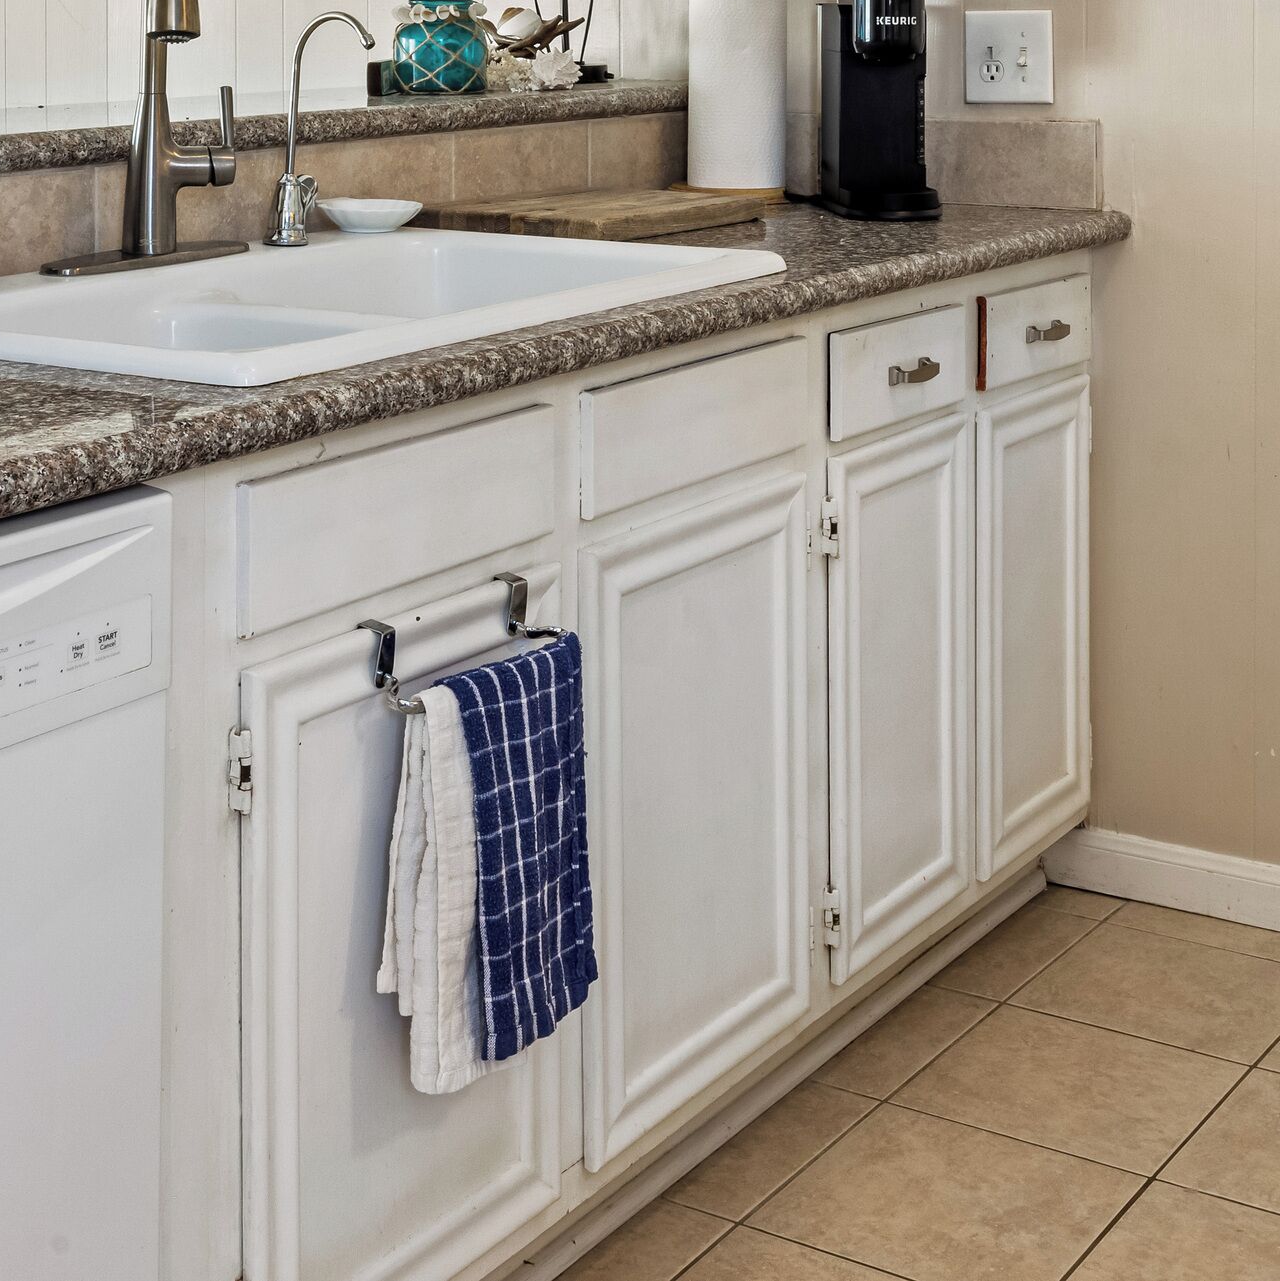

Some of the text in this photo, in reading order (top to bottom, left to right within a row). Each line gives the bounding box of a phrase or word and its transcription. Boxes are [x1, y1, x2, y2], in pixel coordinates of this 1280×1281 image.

[876, 16, 917, 26] KEURIG
[98, 631, 118, 644] START
[72, 643, 85, 652] Heat
[99, 640, 116, 651] Cancel
[73, 651, 83, 659] Dry
